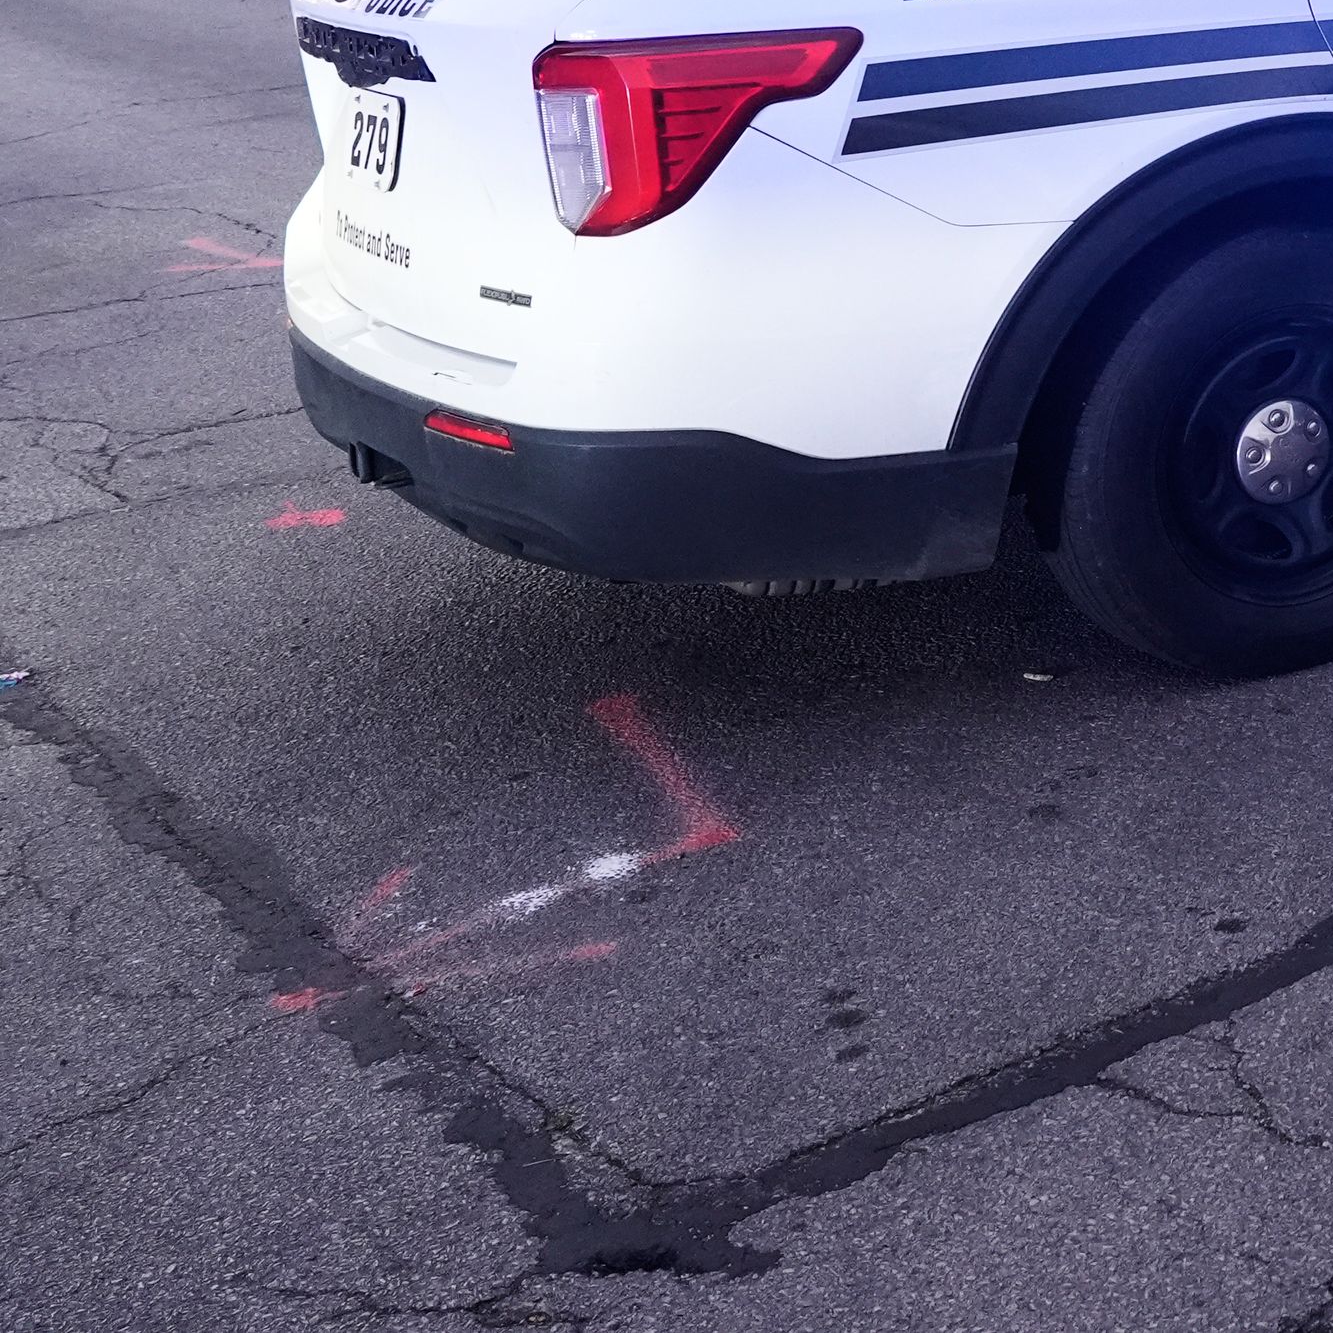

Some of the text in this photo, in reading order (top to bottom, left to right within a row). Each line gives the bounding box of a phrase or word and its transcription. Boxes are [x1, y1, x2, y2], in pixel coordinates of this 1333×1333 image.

[351, 111, 389, 175] 279
[336, 209, 411, 268] To Protect and Serve
